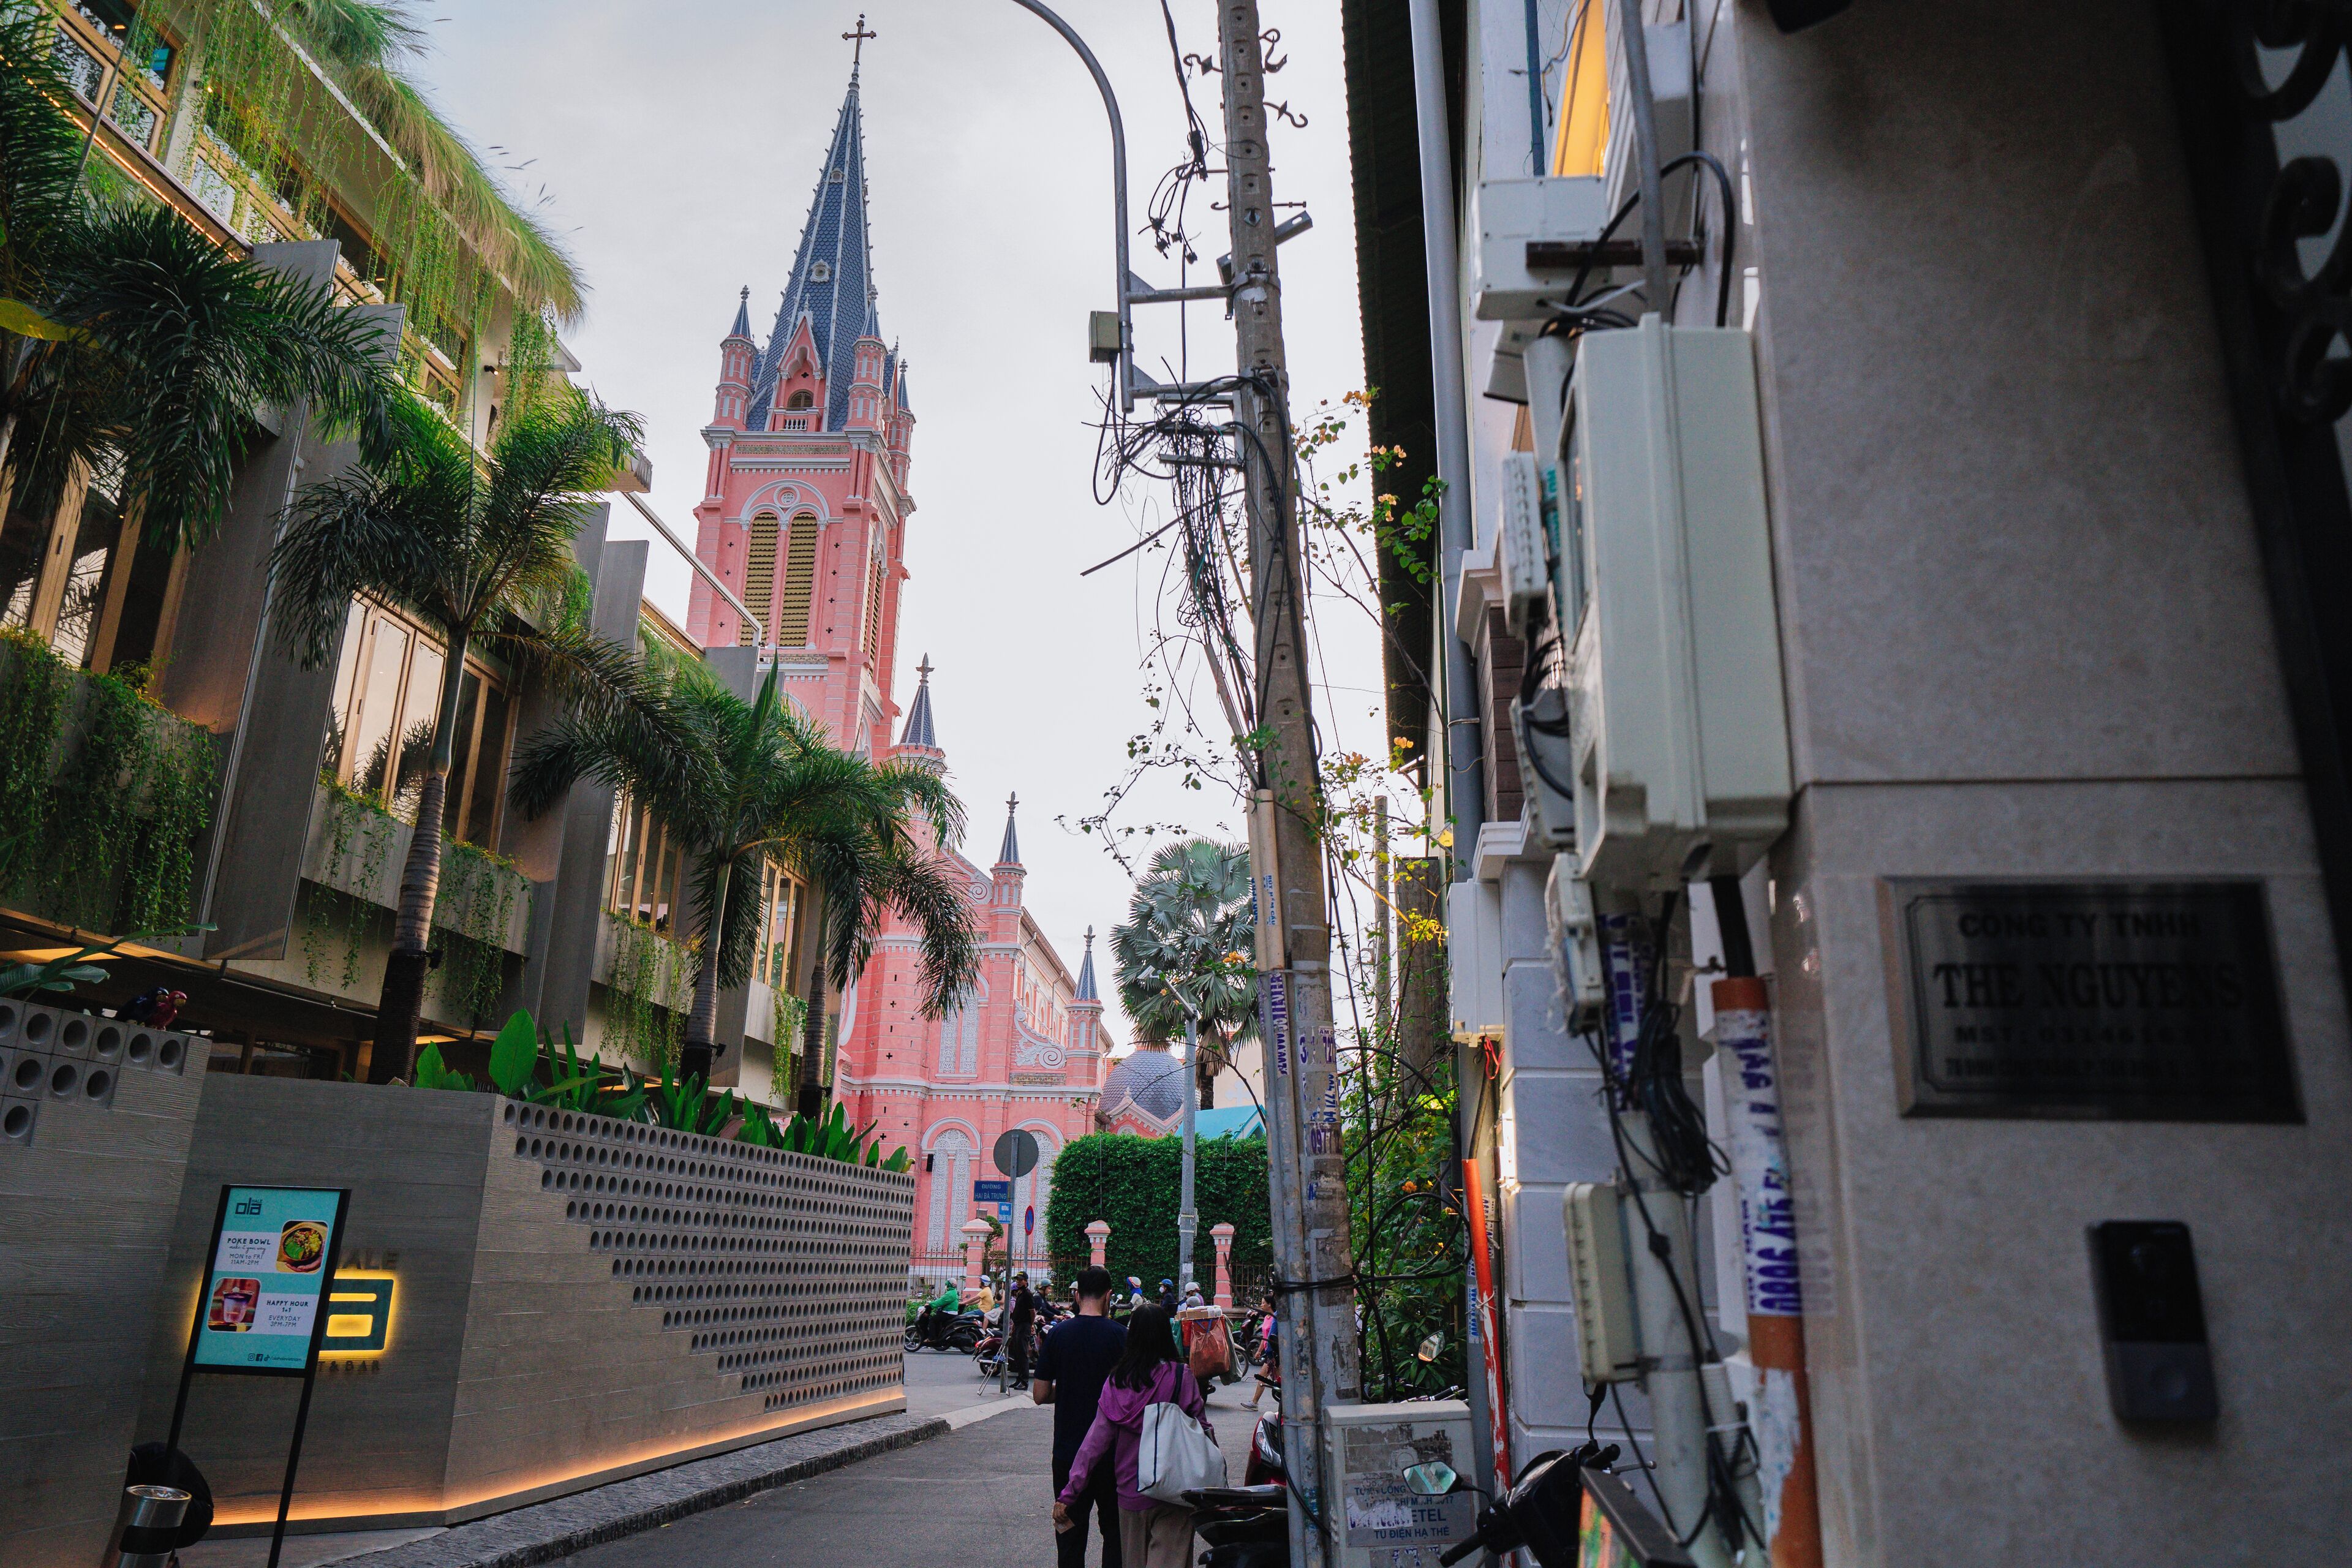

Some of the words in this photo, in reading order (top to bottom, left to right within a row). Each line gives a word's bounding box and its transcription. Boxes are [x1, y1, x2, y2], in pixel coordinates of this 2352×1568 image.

[2059, 913, 2097, 937] TY
[2111, 912, 2203, 938] TNHH
[339, 1250, 400, 1270] ALE
[344, 1361, 380, 1372] BAR
[1412, 1509, 1447, 1523] ETEL
[1389, 1528, 1412, 1540] ĐIỆN
[1415, 1529, 1429, 1539] HẠ
